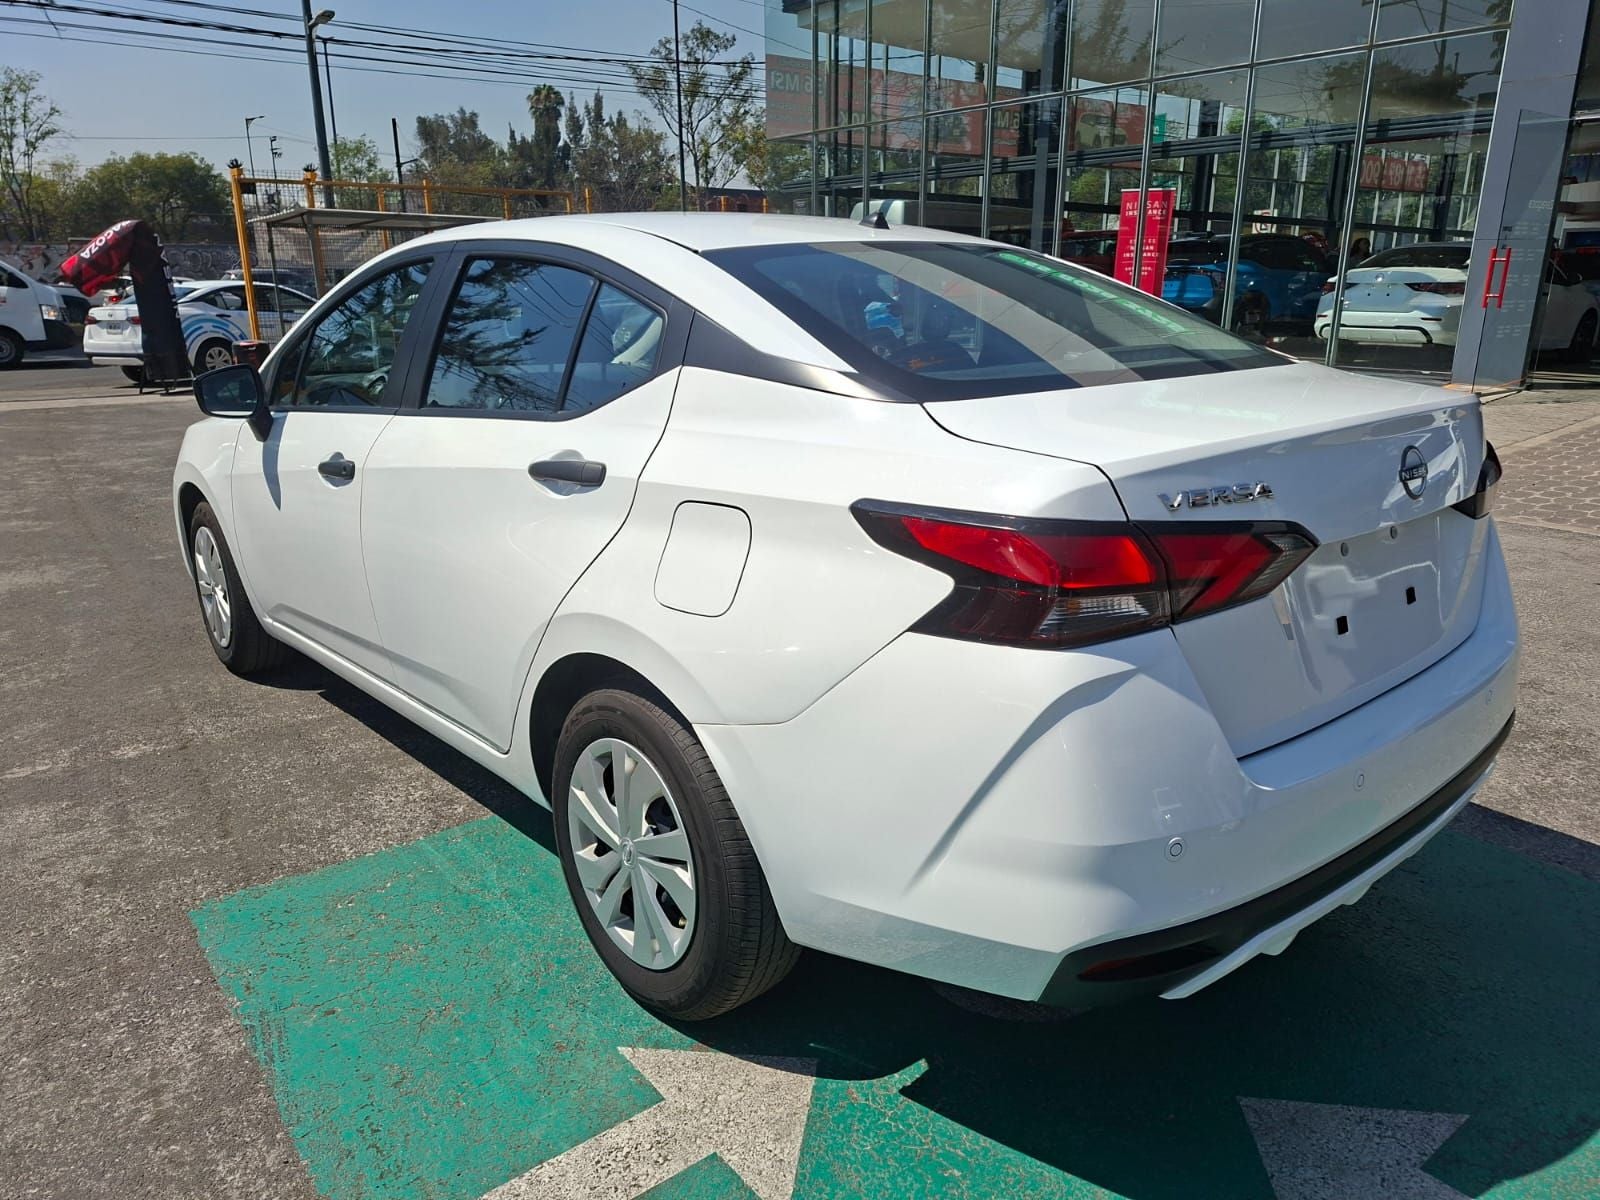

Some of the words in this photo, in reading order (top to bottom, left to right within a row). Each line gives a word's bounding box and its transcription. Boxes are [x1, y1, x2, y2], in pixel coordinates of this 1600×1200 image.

[1126, 200, 1168, 210] NISAN
[1125, 209, 1167, 217] INSANCE
[1157, 480, 1273, 512] VERSA
